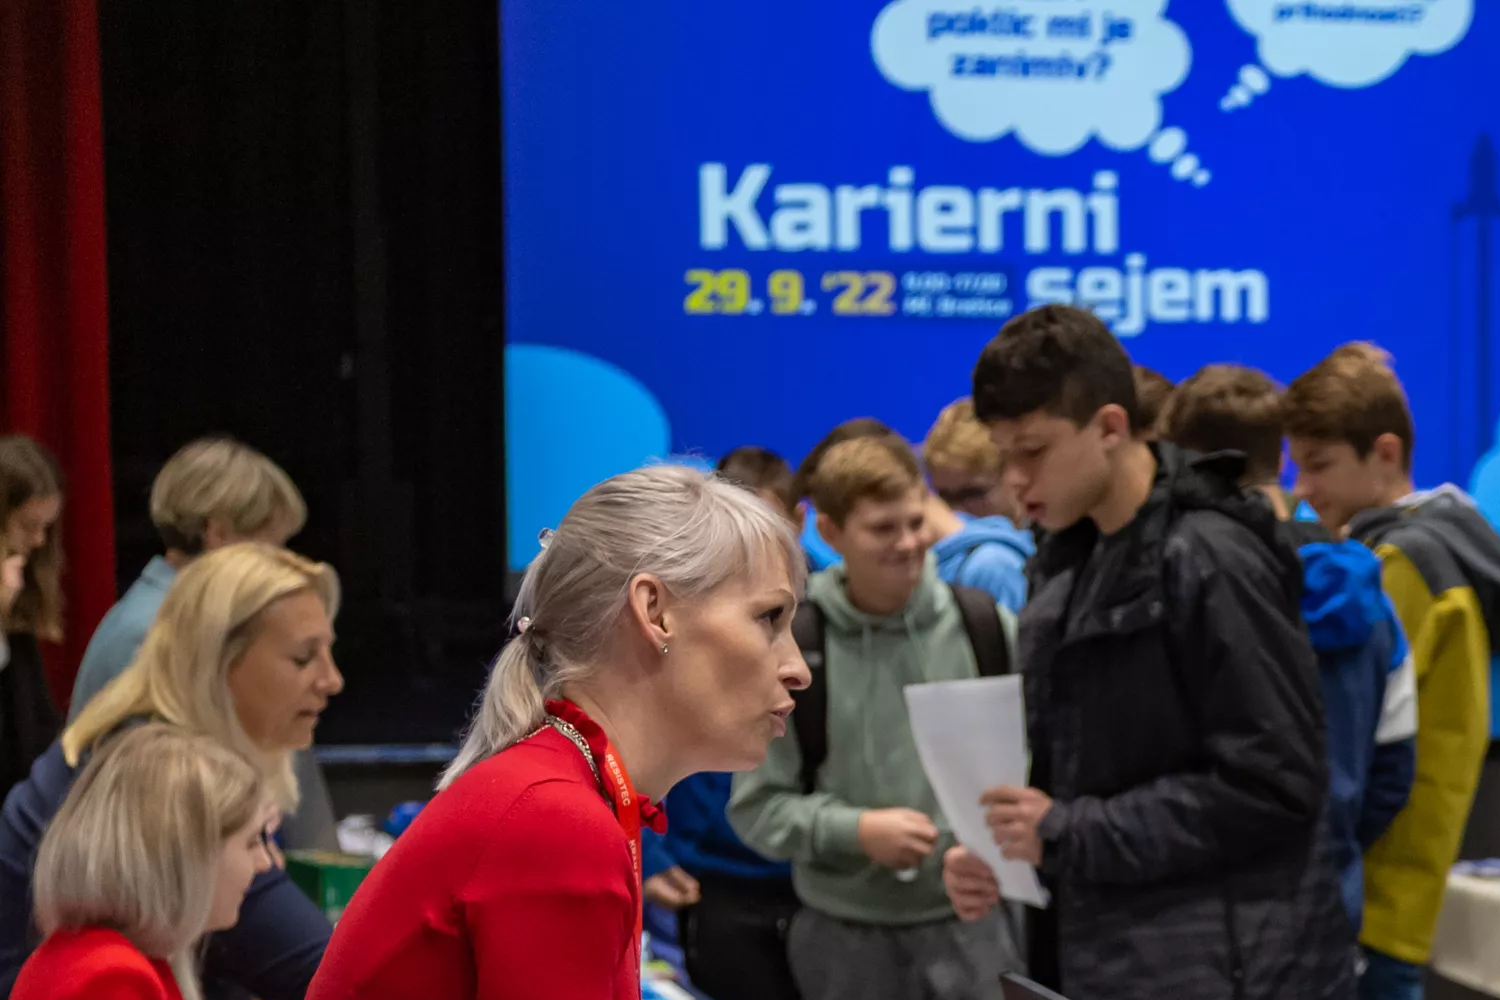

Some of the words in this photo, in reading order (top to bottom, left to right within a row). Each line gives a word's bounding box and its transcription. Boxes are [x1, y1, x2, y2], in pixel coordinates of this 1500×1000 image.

[699, 164, 1120, 255] Karierni
[1026, 253, 1268, 336] sejem
[606, 754, 631, 807] RESISTEC
